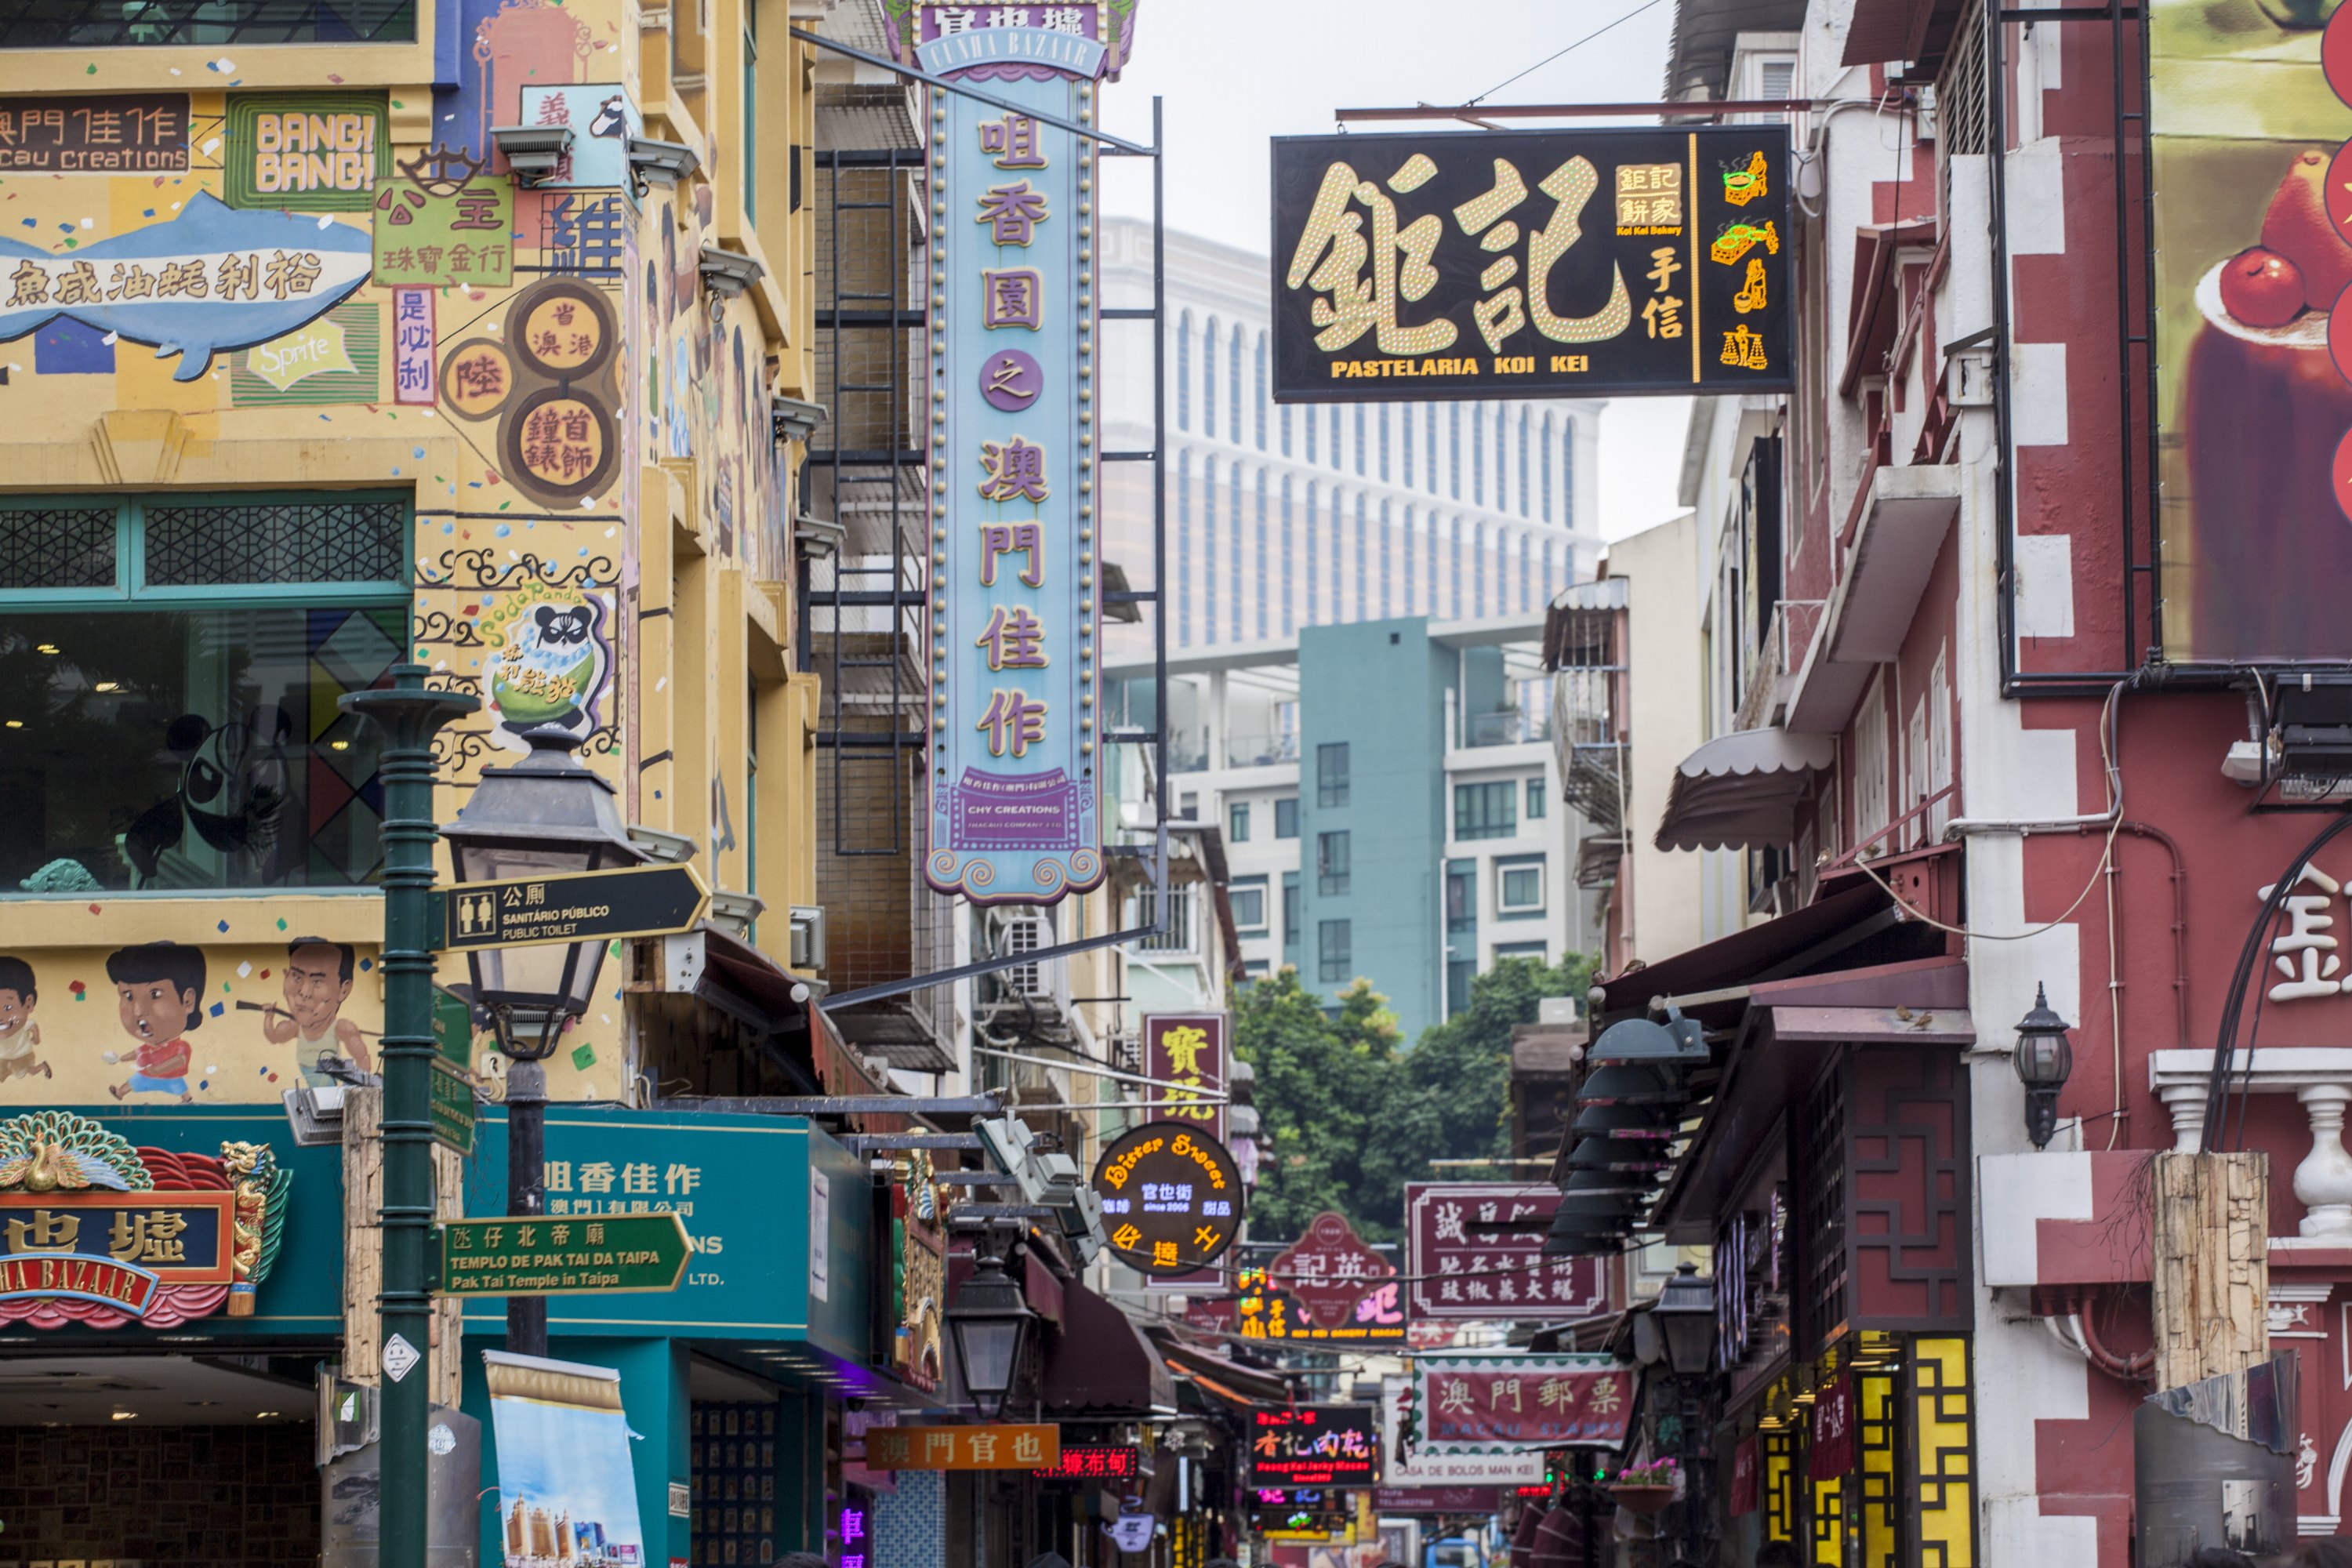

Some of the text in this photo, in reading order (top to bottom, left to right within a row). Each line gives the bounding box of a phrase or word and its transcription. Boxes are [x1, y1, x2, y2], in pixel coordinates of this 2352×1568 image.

[931, 31, 1088, 68] CUNHA BAZAAR
[256, 113, 376, 153] BANG!
[60, 149, 188, 170] creations
[256, 152, 376, 192] BANG!
[376, 187, 504, 231] 公主
[383, 243, 506, 274] 珠寶金行
[1641, 246, 1684, 339] 手信
[260, 333, 330, 377] Sprite
[1331, 355, 1589, 378] PASTELARIA KOI KEI
[455, 355, 505, 401] 陸
[480, 583, 582, 647] Soda Panda
[994, 806, 1061, 815] CREATIONS
[503, 905, 610, 926] SANITÁRIO PÚBLICO
[503, 923, 579, 940] PUBLIC TOILET
[1105, 1134, 1226, 1191] Bitter Sweet
[451, 1250, 660, 1270] TEMPLO DE PAK TAI DA TAIPA
[40, 1259, 137, 1302] BAZAAR
[451, 1271, 619, 1290] Pak Tai Temple in Taipa
[688, 1272, 725, 1286] LTD.
[1439, 1376, 1622, 1415] 澳門郵票
[1442, 1421, 1622, 1436] MACAU STAMPS
[1395, 1465, 1534, 1477] CASA DE BOLOS MAN KEI
